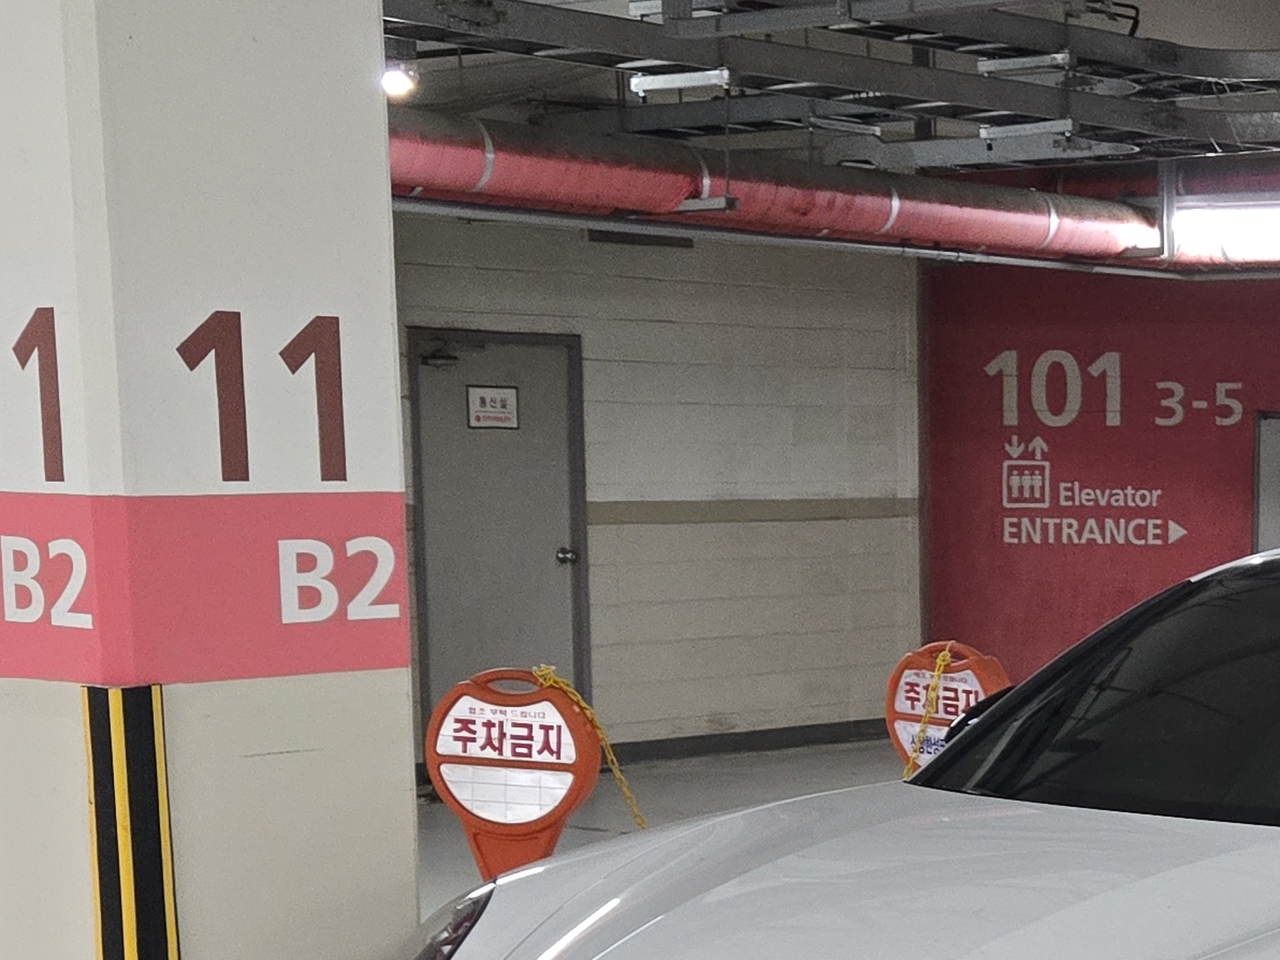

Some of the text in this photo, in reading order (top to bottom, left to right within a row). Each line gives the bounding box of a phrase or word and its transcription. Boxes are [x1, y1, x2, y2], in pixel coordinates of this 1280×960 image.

[176, 311, 347, 482] 11
[983, 350, 1243, 427] 101 3-5
[1003, 518, 1162, 545] ENTRANCE
[1059, 482, 1161, 508] Elevator
[0, 535, 93, 630] B2
[277, 535, 400, 624] B2
[453, 718, 562, 760] 주차금지
